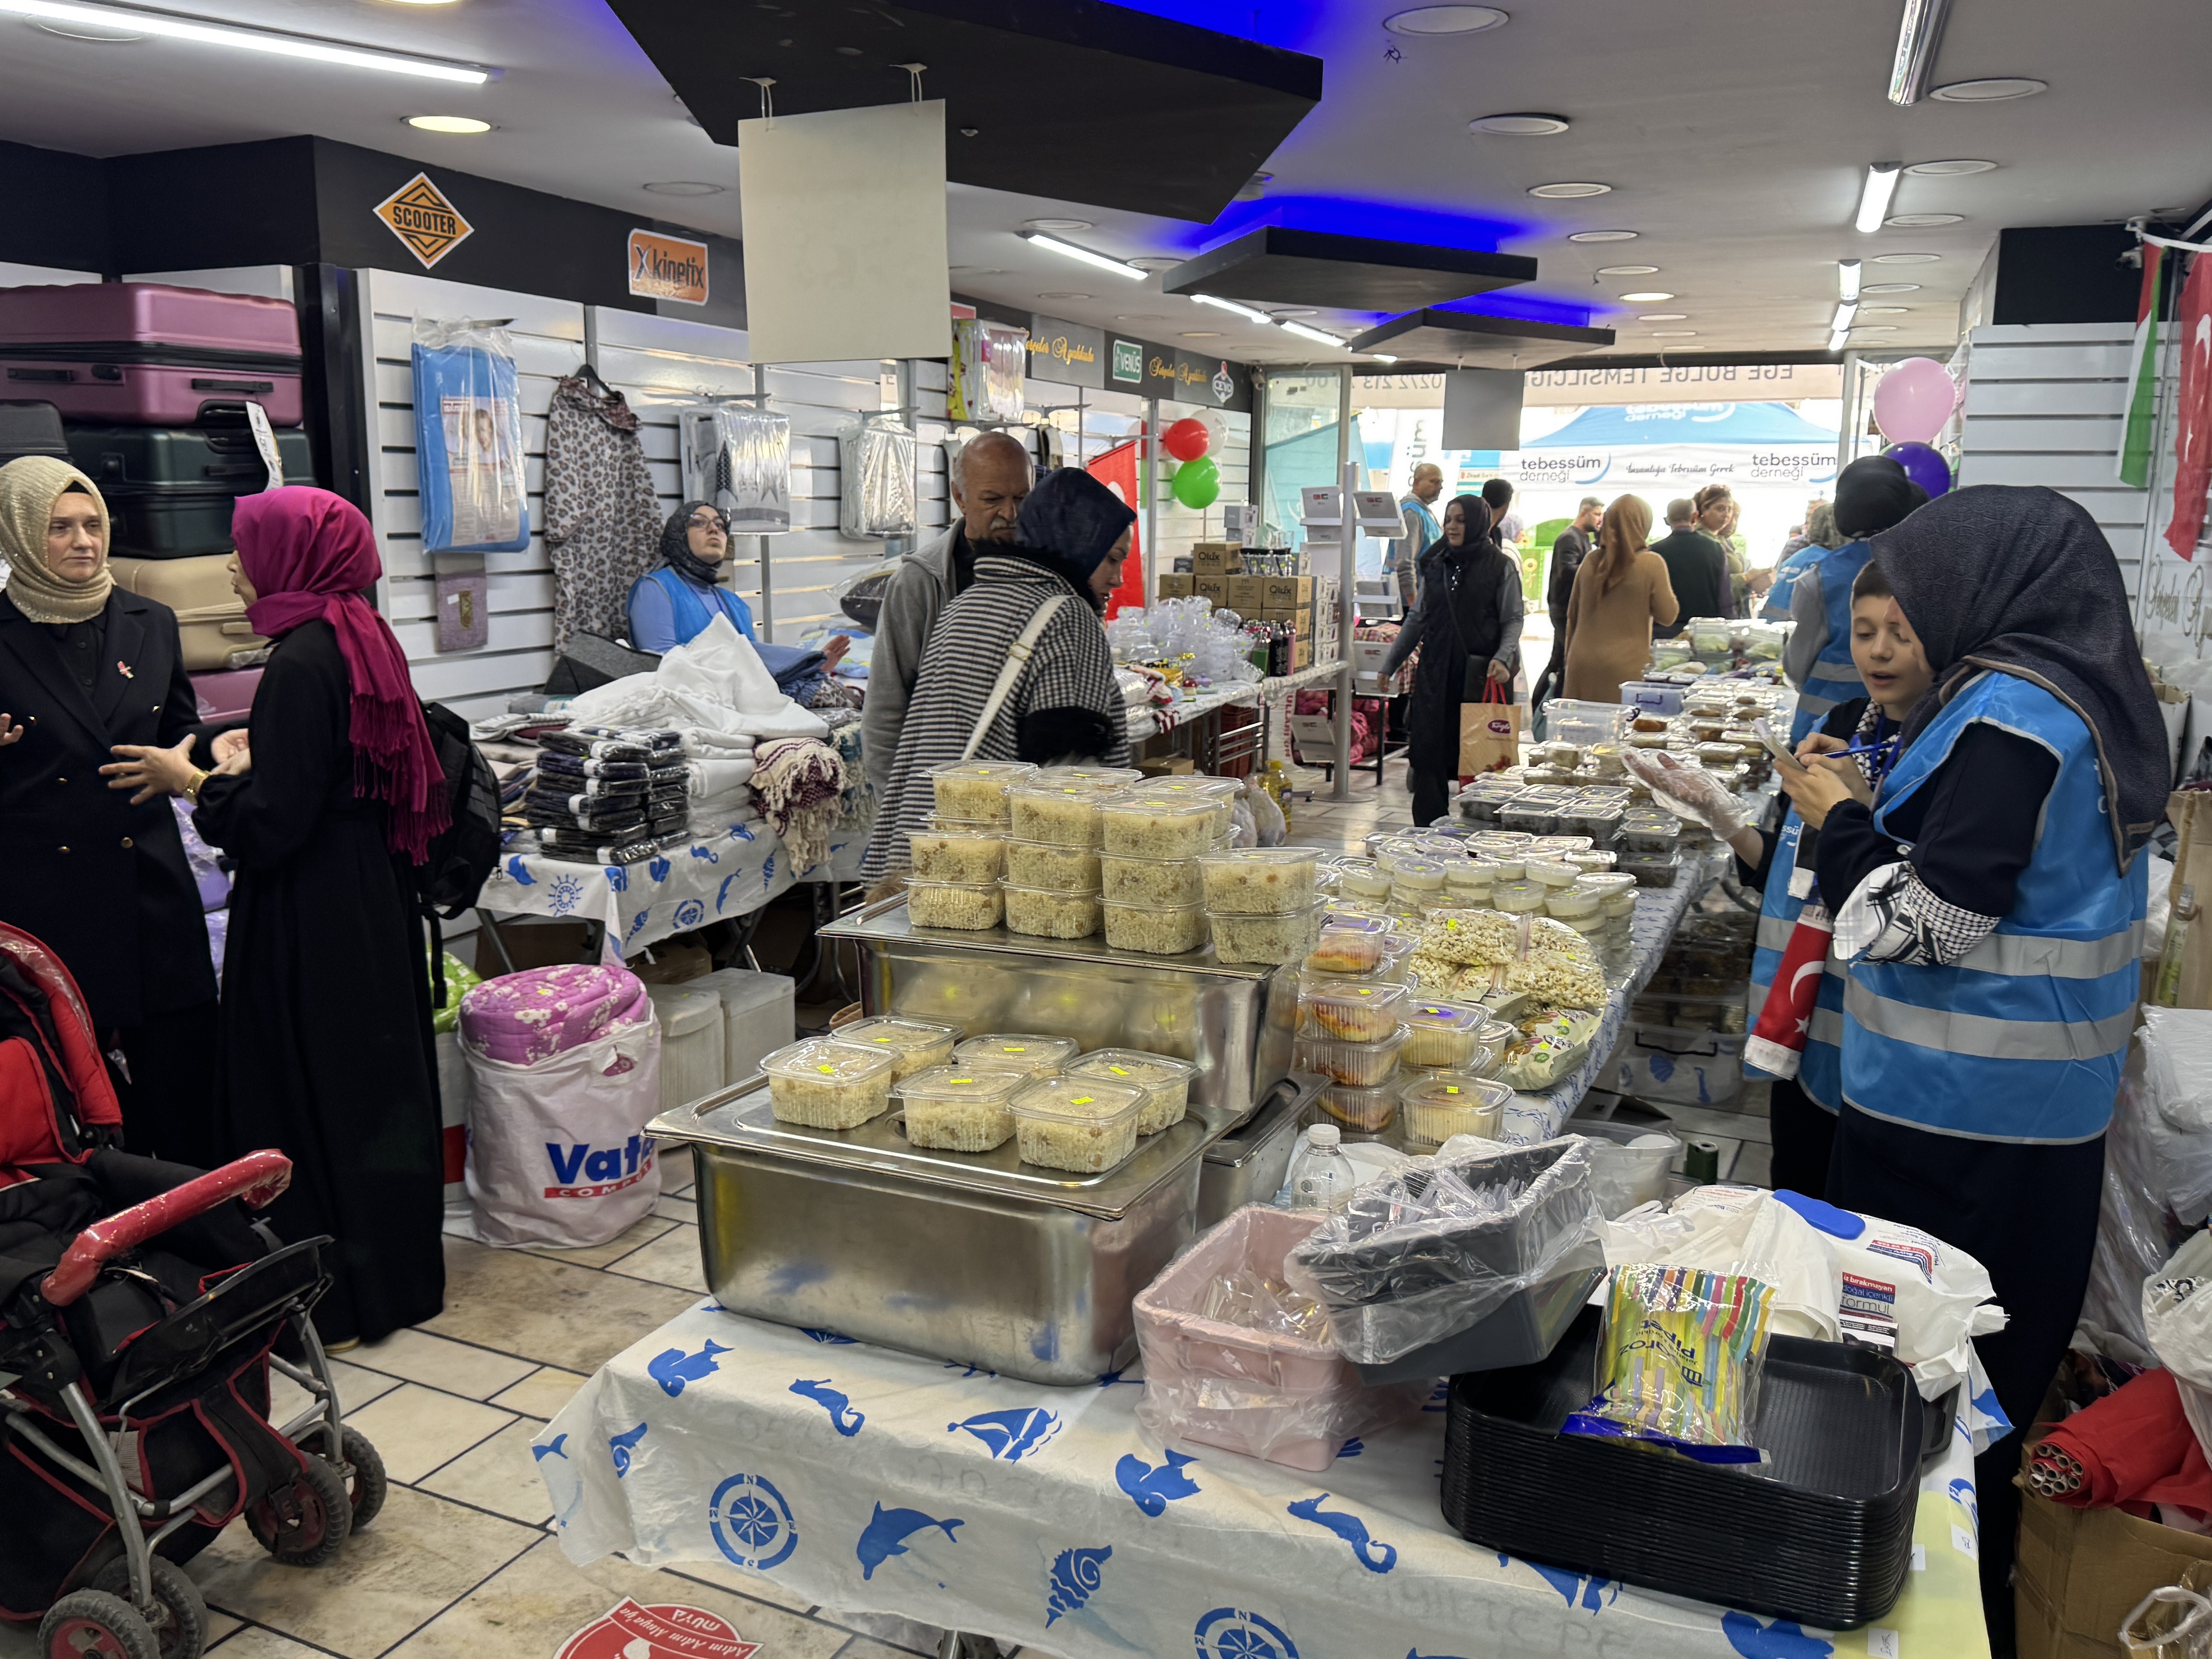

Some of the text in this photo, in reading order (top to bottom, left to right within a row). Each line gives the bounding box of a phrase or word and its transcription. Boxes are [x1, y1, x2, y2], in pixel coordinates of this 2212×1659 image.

[393, 206, 456, 235] SCOOTER
[1521, 455, 1601, 470] tebessüm
[1752, 452, 1837, 466] tebessüm
[1519, 469, 1570, 483] derneği
[1751, 466, 1804, 480] derneği
[669, 1633, 707, 1649] Adım
[708, 1643, 750, 1657] Adım
